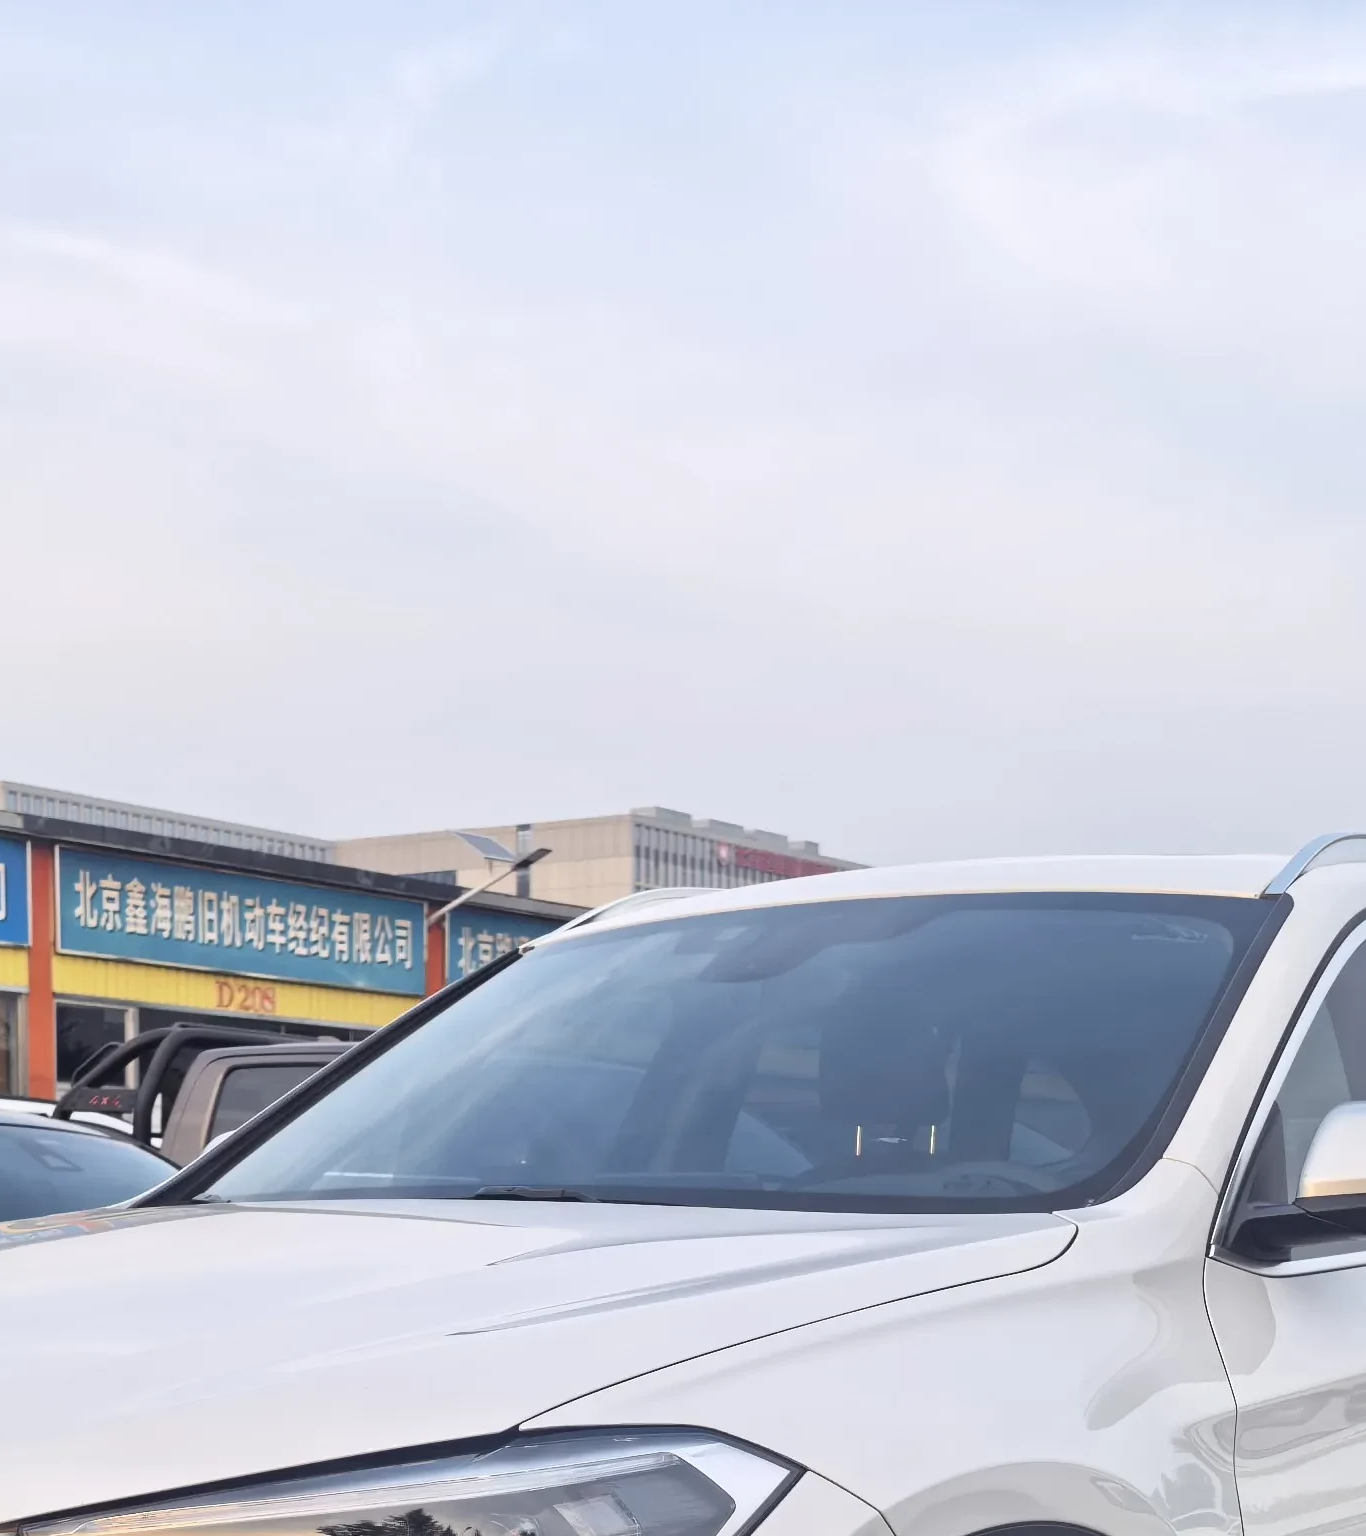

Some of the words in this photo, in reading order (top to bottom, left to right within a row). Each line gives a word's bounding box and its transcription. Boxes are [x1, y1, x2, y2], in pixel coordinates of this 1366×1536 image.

[74, 868, 413, 970] 北京鑫海鹏旧机动车经纪有限公司
[457, 926, 531, 977] 北京
[215, 979, 276, 1015] D208
